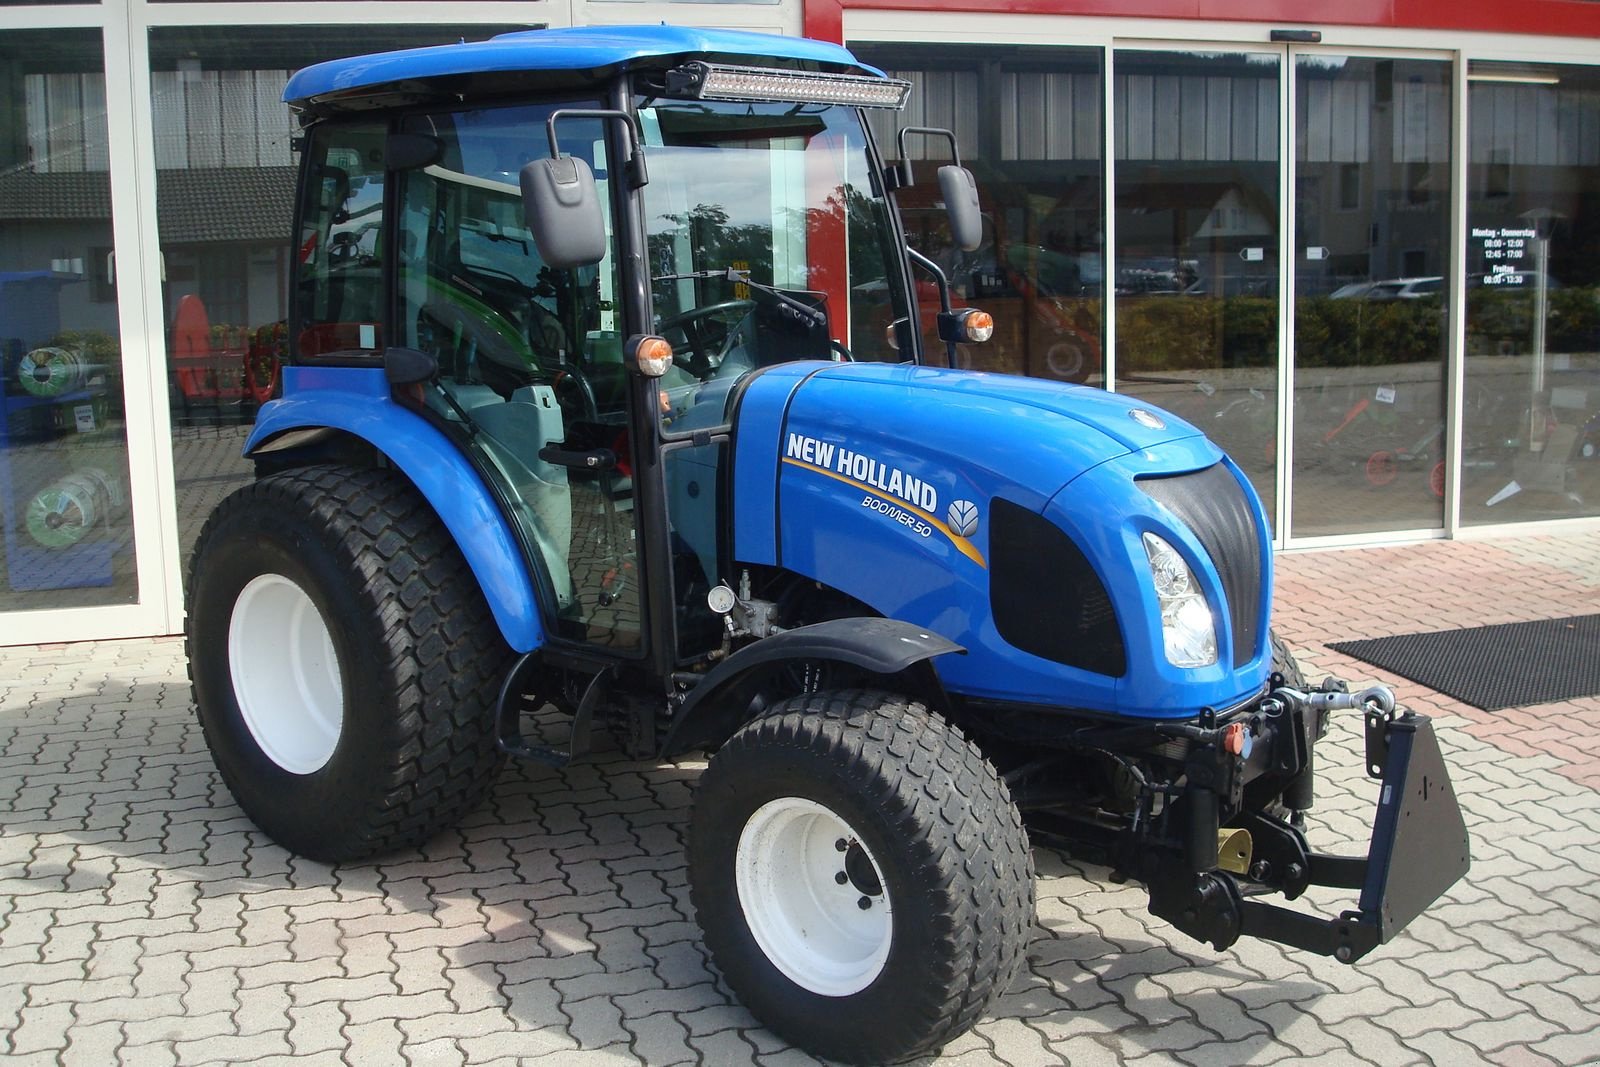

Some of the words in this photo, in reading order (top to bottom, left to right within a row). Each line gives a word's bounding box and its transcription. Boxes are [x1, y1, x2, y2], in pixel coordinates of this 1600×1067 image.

[1472, 228, 1495, 238] Montag
[1501, 228, 1535, 238] Donnerstag
[1484, 239, 1501, 248] 08:00
[1507, 239, 1523, 248] 12:00
[1485, 250, 1501, 258] 12:45
[1507, 250, 1523, 258] 17:00
[1493, 265, 1514, 274] Freitag
[1484, 275, 1501, 284] 08:00
[1506, 275, 1523, 283] 13:30
[787, 433, 835, 468] NEW
[837, 448, 938, 513] HOLLAND
[861, 496, 917, 528] BOOMER
[912, 522, 932, 537] 50
